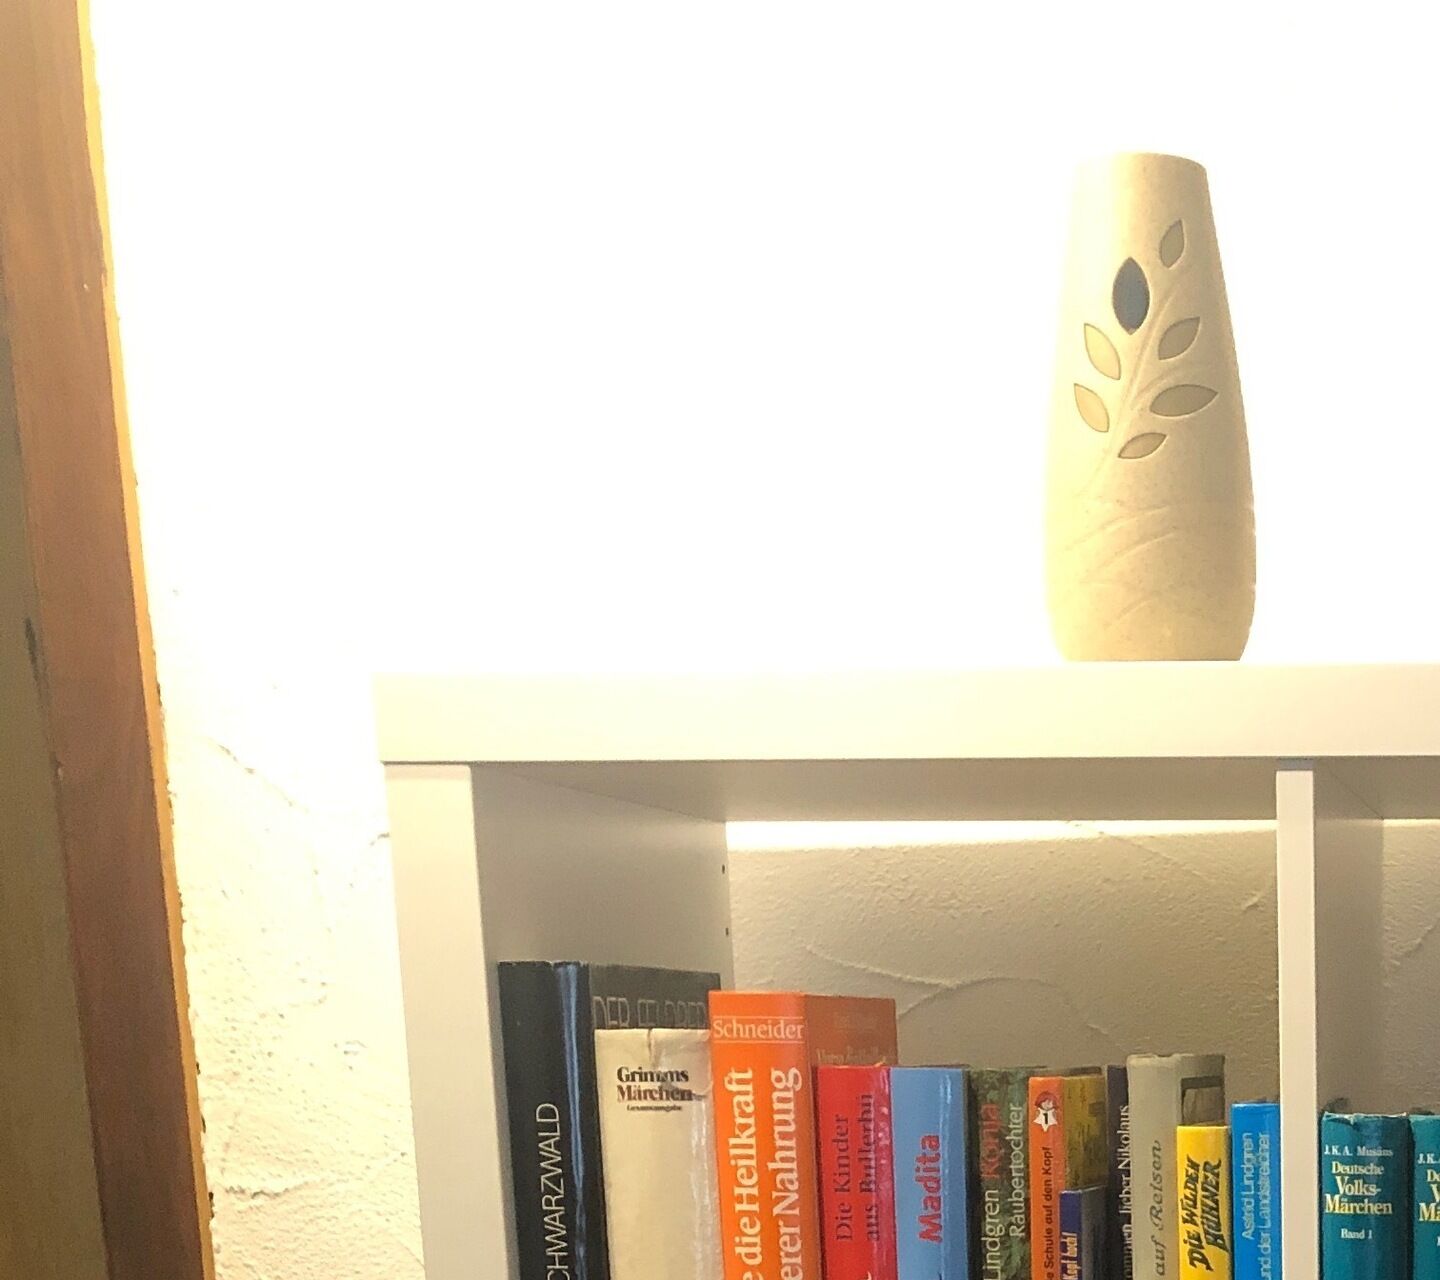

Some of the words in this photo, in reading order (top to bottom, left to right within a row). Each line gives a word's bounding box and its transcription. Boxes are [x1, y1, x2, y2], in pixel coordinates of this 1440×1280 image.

[713, 1020, 804, 1039] Schneider
[616, 1065, 691, 1084] Grimms
[616, 1084, 693, 1102] Märchen
[724, 1067, 760, 1214] Heilkraft
[767, 1066, 803, 1217] Nahrung
[832, 1113, 852, 1193] Kinder
[980, 1102, 1002, 1179] Ronja
[1116, 1104, 1130, 1170] Nikolaus
[1005, 1103, 1026, 1238] Räubertochter
[1240, 1132, 1257, 1196] Lindgren
[1257, 1132, 1273, 1229] Landstreicher
[1332, 1160, 1385, 1175] Deutsche
[914, 1133, 943, 1243] Madita
[1149, 1139, 1164, 1233] Reisen
[1325, 1193, 1393, 1214] Märchen
[1334, 1175, 1382, 1197] Volks-
[735, 1215, 763, 1267] die
[834, 1201, 853, 1241] Die
[867, 1203, 882, 1241] aus
[1241, 1200, 1256, 1241] Astrid
[1340, 1228, 1366, 1240] Band
[1042, 1227, 1054, 1265] Schule
[1151, 1234, 1167, 1277] auf
[1257, 1231, 1272, 1255] der
